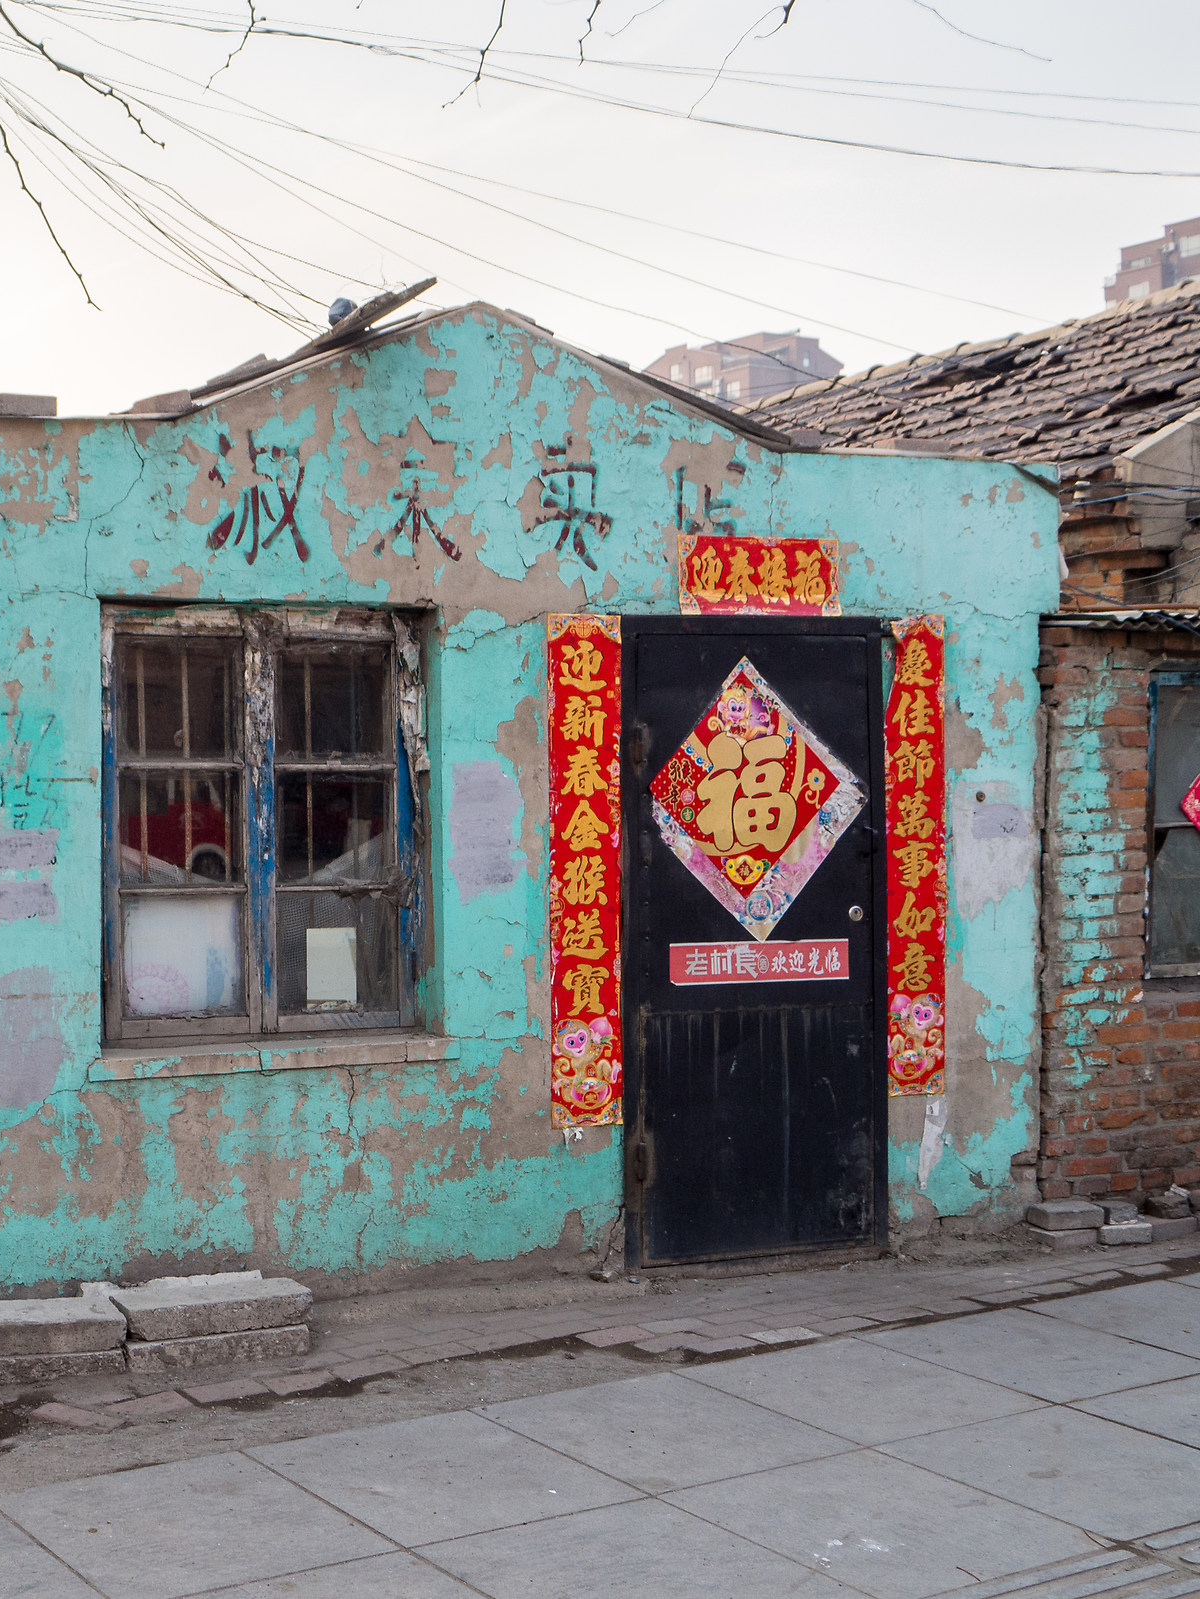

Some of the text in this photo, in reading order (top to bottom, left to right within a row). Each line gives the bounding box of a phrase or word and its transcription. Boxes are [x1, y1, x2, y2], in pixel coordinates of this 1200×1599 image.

[691, 545, 827, 606] 迎春接福
[559, 640, 610, 1016] 迎新春金猴送寶
[696, 731, 798, 852] 福
[891, 638, 937, 991] 慶佳節萬事如意
[771, 946, 841, 975] 欢迎光临
